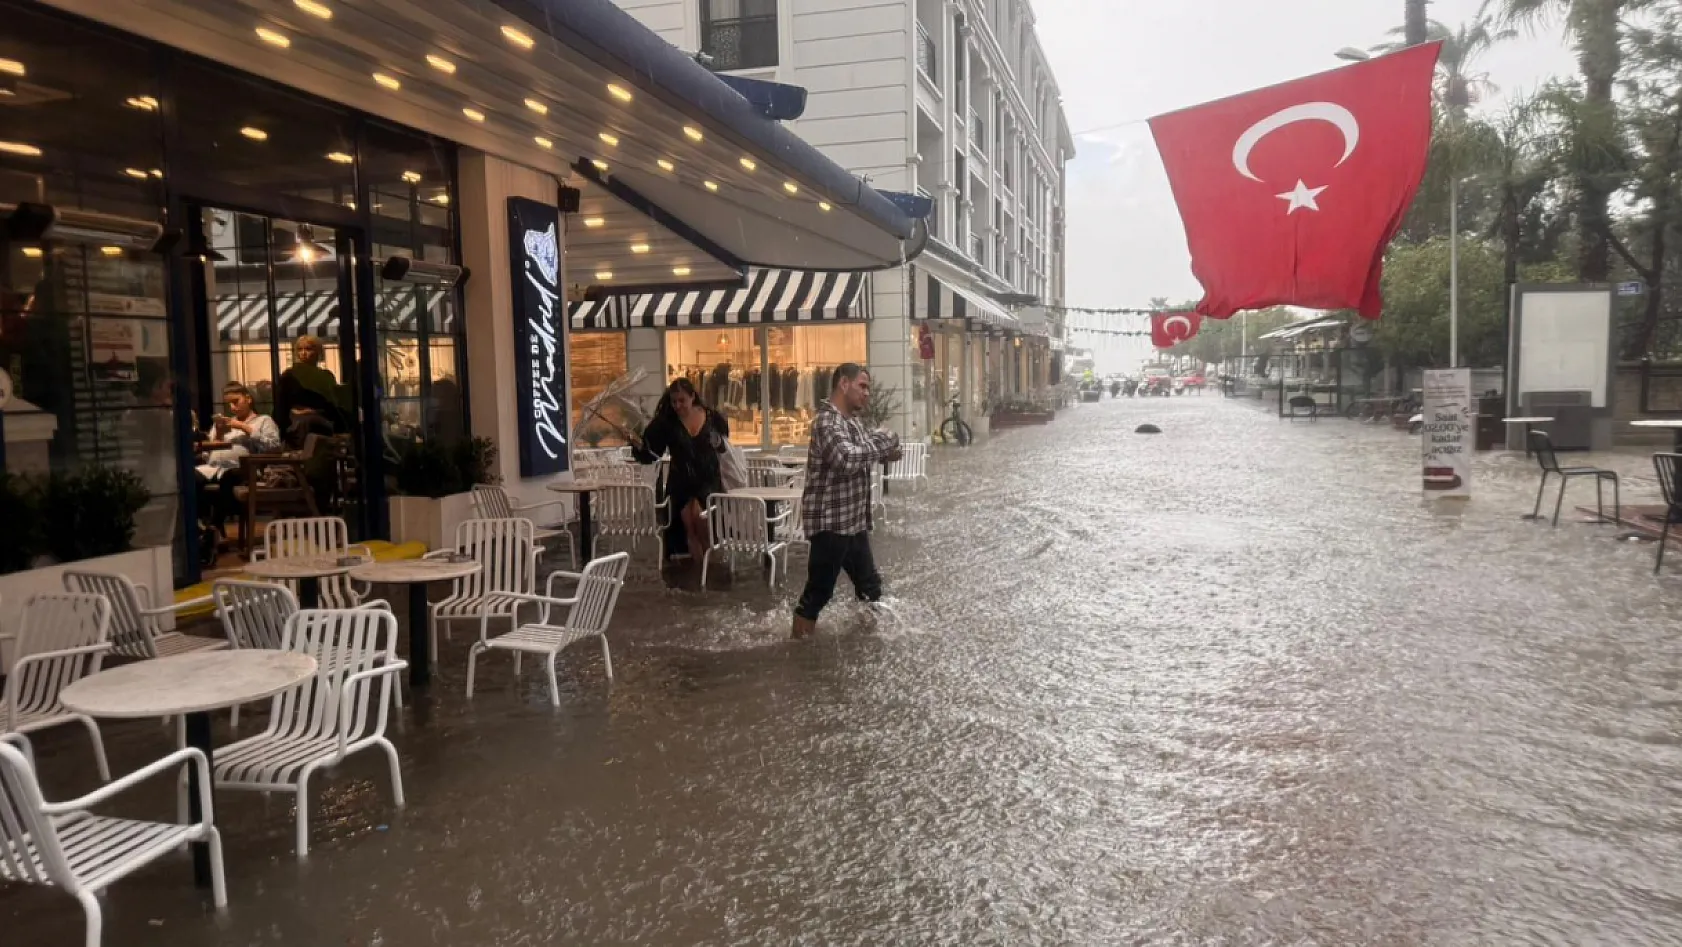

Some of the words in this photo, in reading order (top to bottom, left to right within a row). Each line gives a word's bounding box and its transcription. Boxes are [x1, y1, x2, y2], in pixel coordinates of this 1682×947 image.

[525, 270, 567, 459] Madrid
[529, 333, 540, 354] DE
[531, 358, 543, 418] COFFEE
